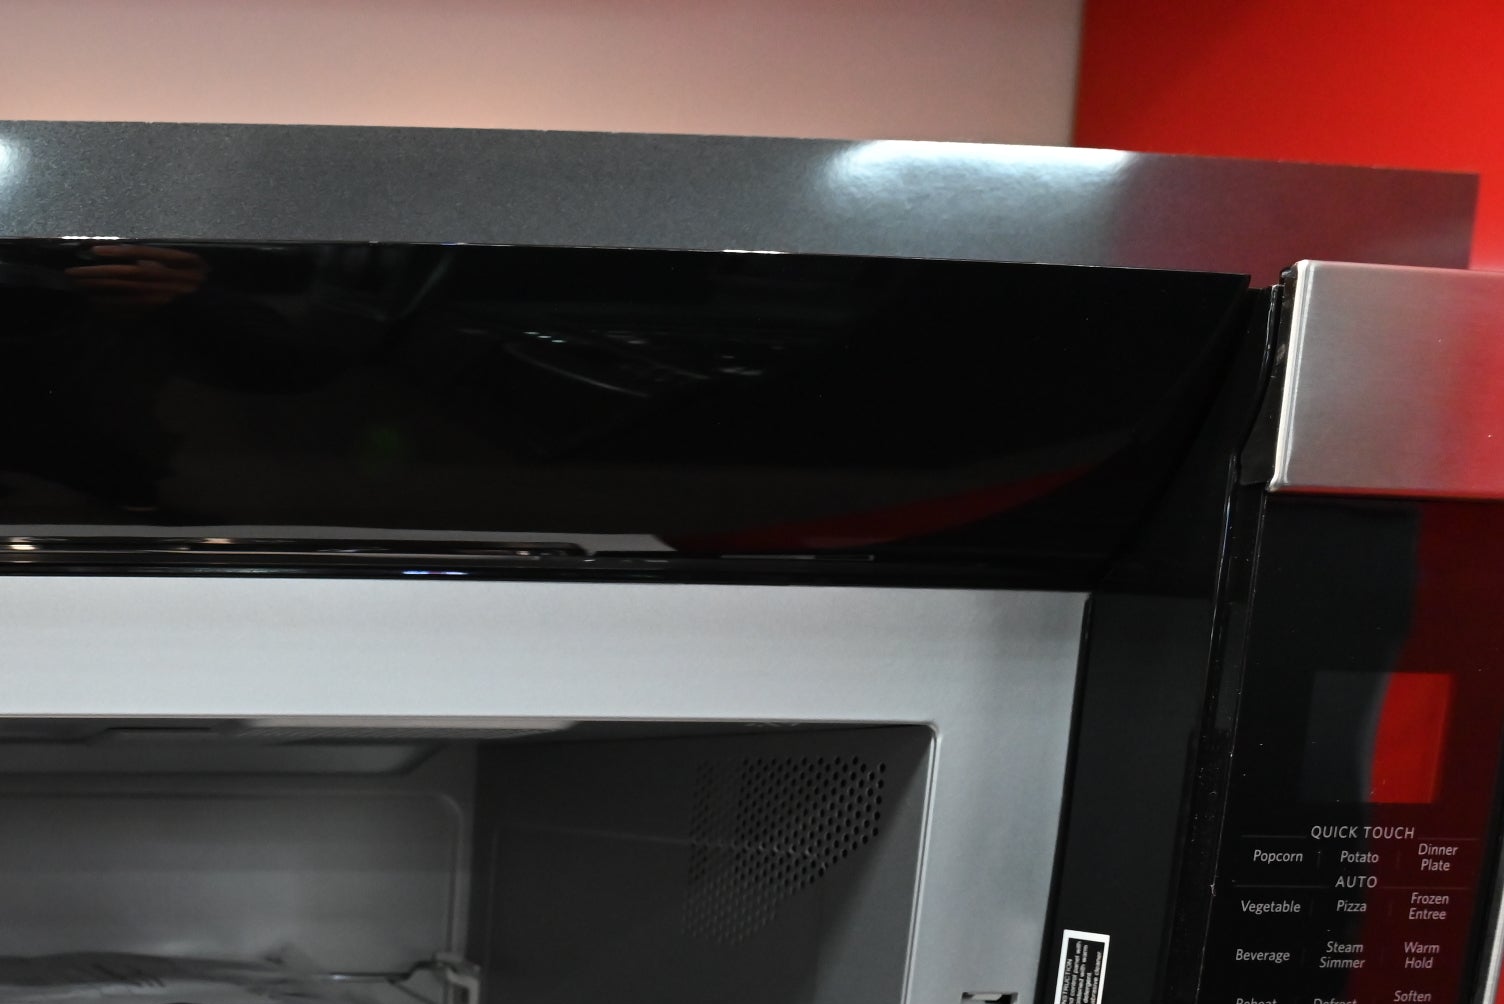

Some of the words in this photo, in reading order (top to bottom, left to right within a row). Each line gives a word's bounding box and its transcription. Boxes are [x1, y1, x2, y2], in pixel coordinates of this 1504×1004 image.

[1311, 826, 1358, 839] QUICK
[1364, 827, 1414, 839] TOUCH
[1418, 844, 1458, 855] Dinner
[1254, 850, 1303, 864] Popcorn
[1341, 851, 1378, 862] Potato
[1421, 859, 1450, 871] Plate
[1335, 876, 1377, 888] AUTO
[1411, 892, 1449, 904] Frozen
[1241, 900, 1300, 914] Vegetable
[1337, 900, 1366, 911] Pizza
[1409, 908, 1446, 919] Entree
[1326, 941, 1363, 952] Steam
[1405, 942, 1439, 953] Warm
[1236, 949, 1290, 963] Beverage
[1320, 957, 1365, 968] Simmer
[1405, 957, 1433, 968] Hold
[1394, 991, 1431, 1001] Soften
